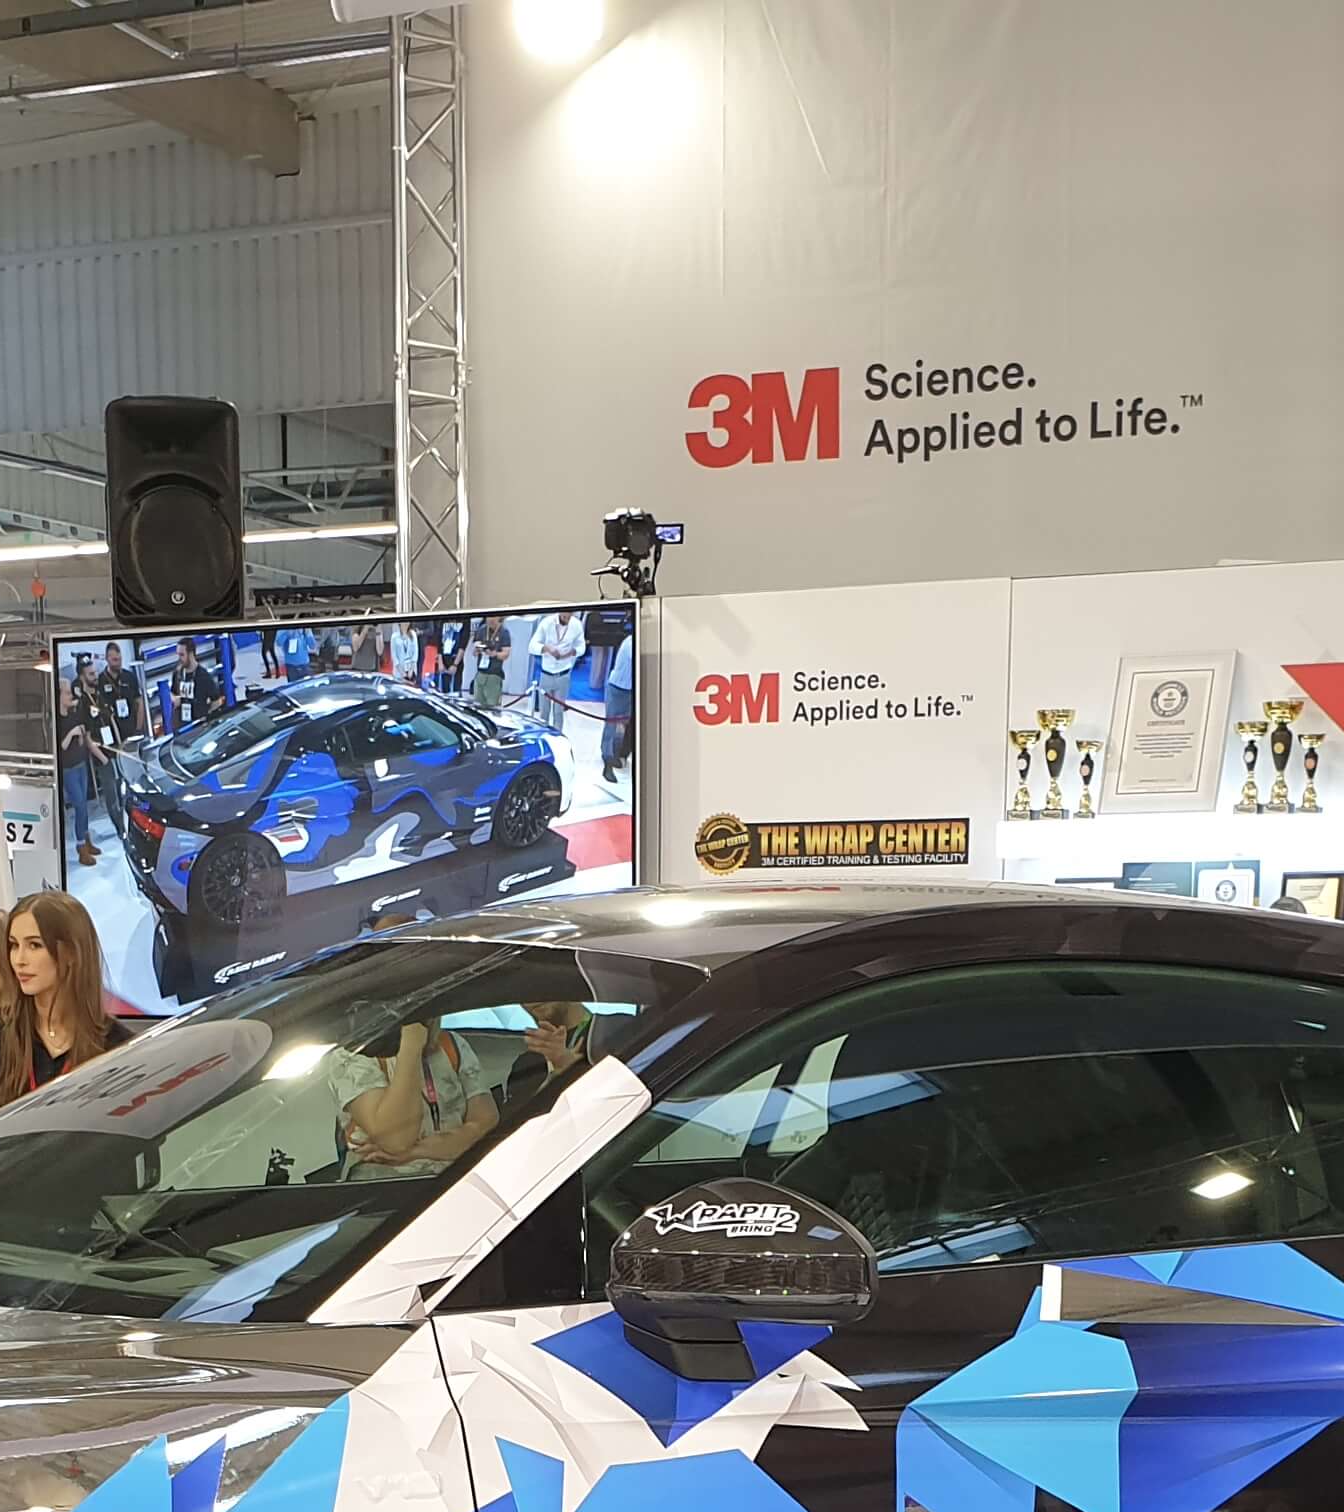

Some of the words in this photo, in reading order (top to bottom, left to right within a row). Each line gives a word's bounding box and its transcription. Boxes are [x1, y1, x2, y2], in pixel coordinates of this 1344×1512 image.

[864, 359, 1037, 401] Science.
[685, 366, 841, 469] 3M
[864, 406, 1024, 462] Applied
[1036, 413, 1077, 443] to
[692, 672, 780, 726] 3M
[793, 671, 887, 692] Science.
[793, 697, 879, 727] Applied
[885, 702, 907, 719] to
[758, 824, 800, 856] THE
[804, 822, 875, 856] WRAP
[879, 819, 968, 854] CENTER
[761, 857, 775, 867] 3M
[776, 855, 825, 867] CERTIFIED
[827, 854, 871, 866] TRAINING
[873, 854, 880, 865] &
[881, 853, 923, 866] TESTING
[924, 853, 967, 865] FACILITY
